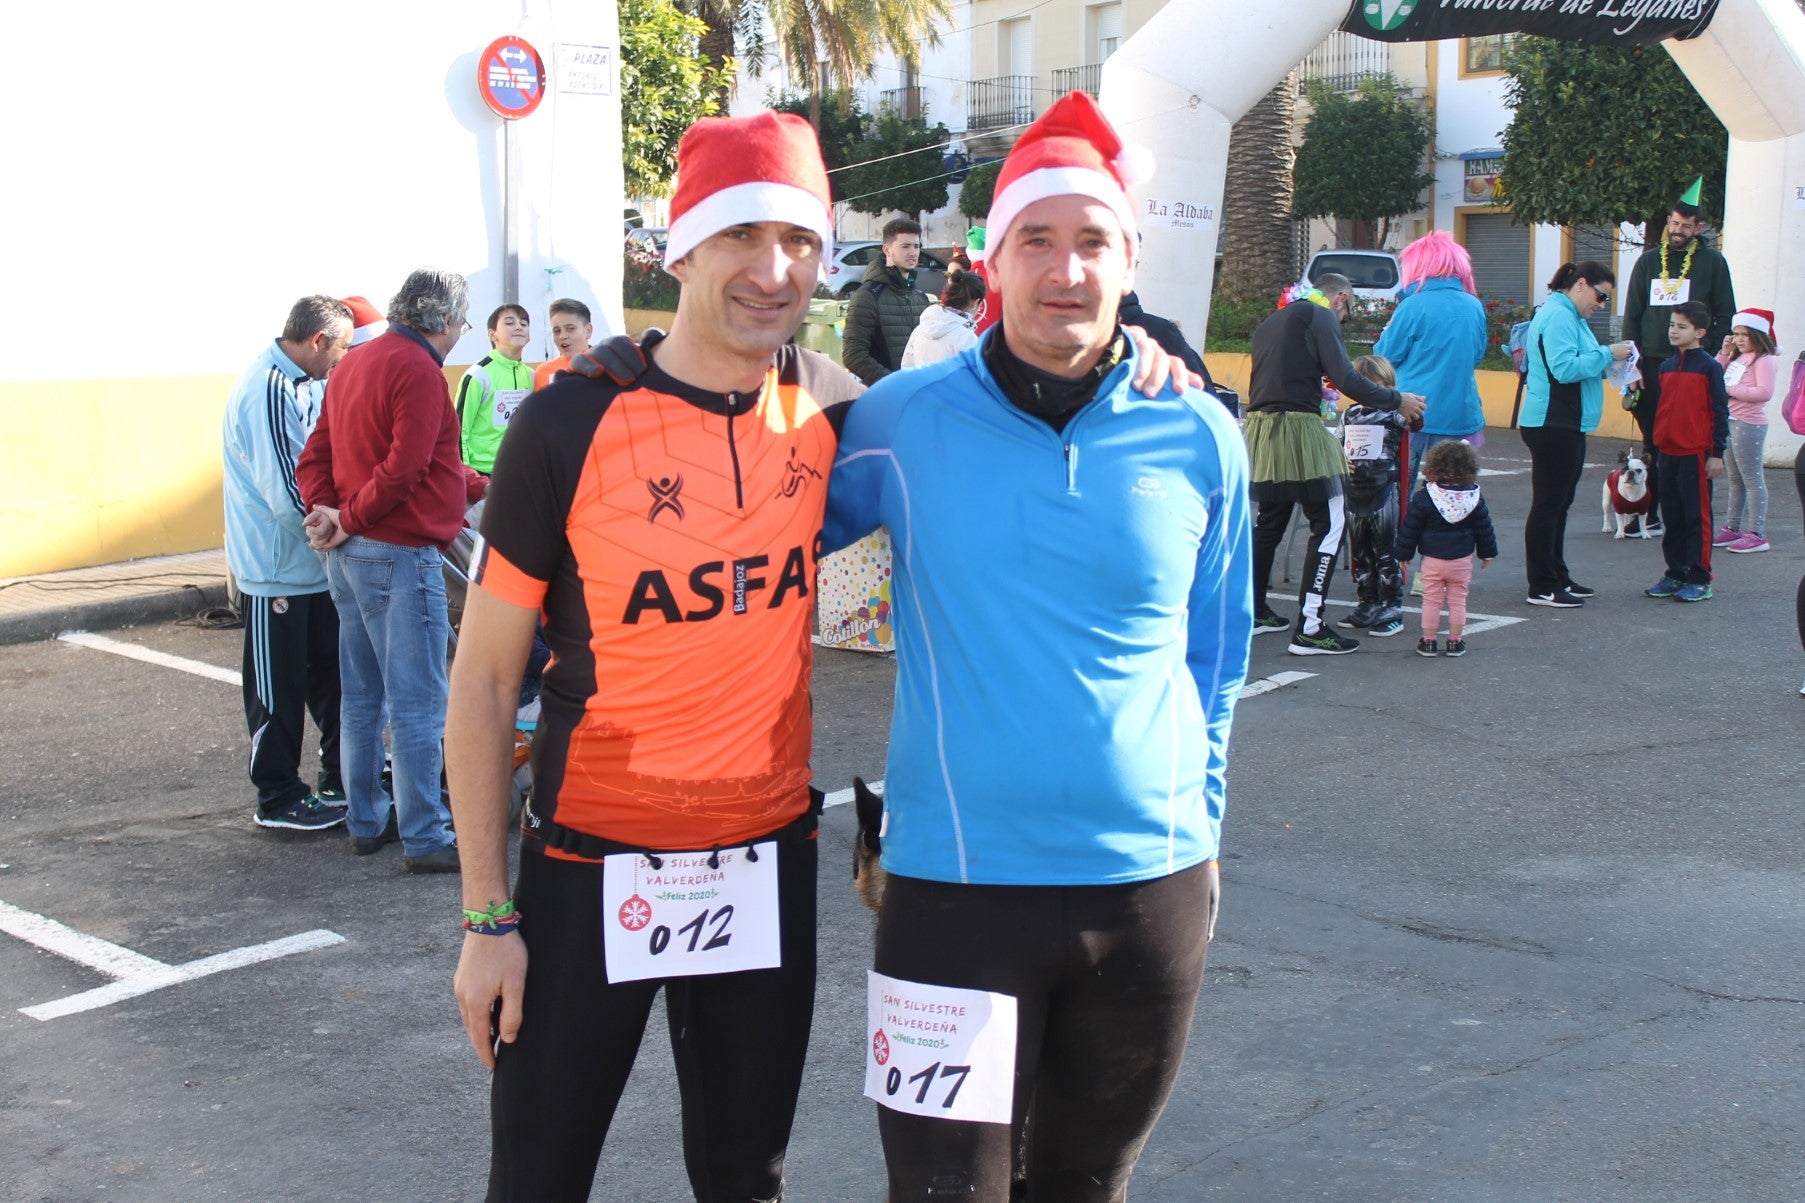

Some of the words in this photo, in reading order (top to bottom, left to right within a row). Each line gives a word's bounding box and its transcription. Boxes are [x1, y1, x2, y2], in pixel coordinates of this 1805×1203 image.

[574, 52, 607, 65] PLAZA
[1147, 199, 1167, 216] La
[1174, 202, 1213, 220] Aldaba
[1350, 443, 1372, 457] 015
[733, 564, 745, 613] Badajoz
[671, 854, 733, 869] SILVERE
[646, 871, 725, 886] VALVERDEÑA
[667, 892, 686, 900] Feliz
[688, 890, 711, 900] 2020
[649, 904, 735, 956] 012
[883, 994, 901, 1007] SAN
[904, 1000, 967, 1017] SILVESTRE
[887, 1013, 958, 1035] VALVERDEÑA
[900, 1034, 915, 1044] Feliz
[917, 1037, 940, 1048] 2020
[886, 1061, 972, 1109] 017
